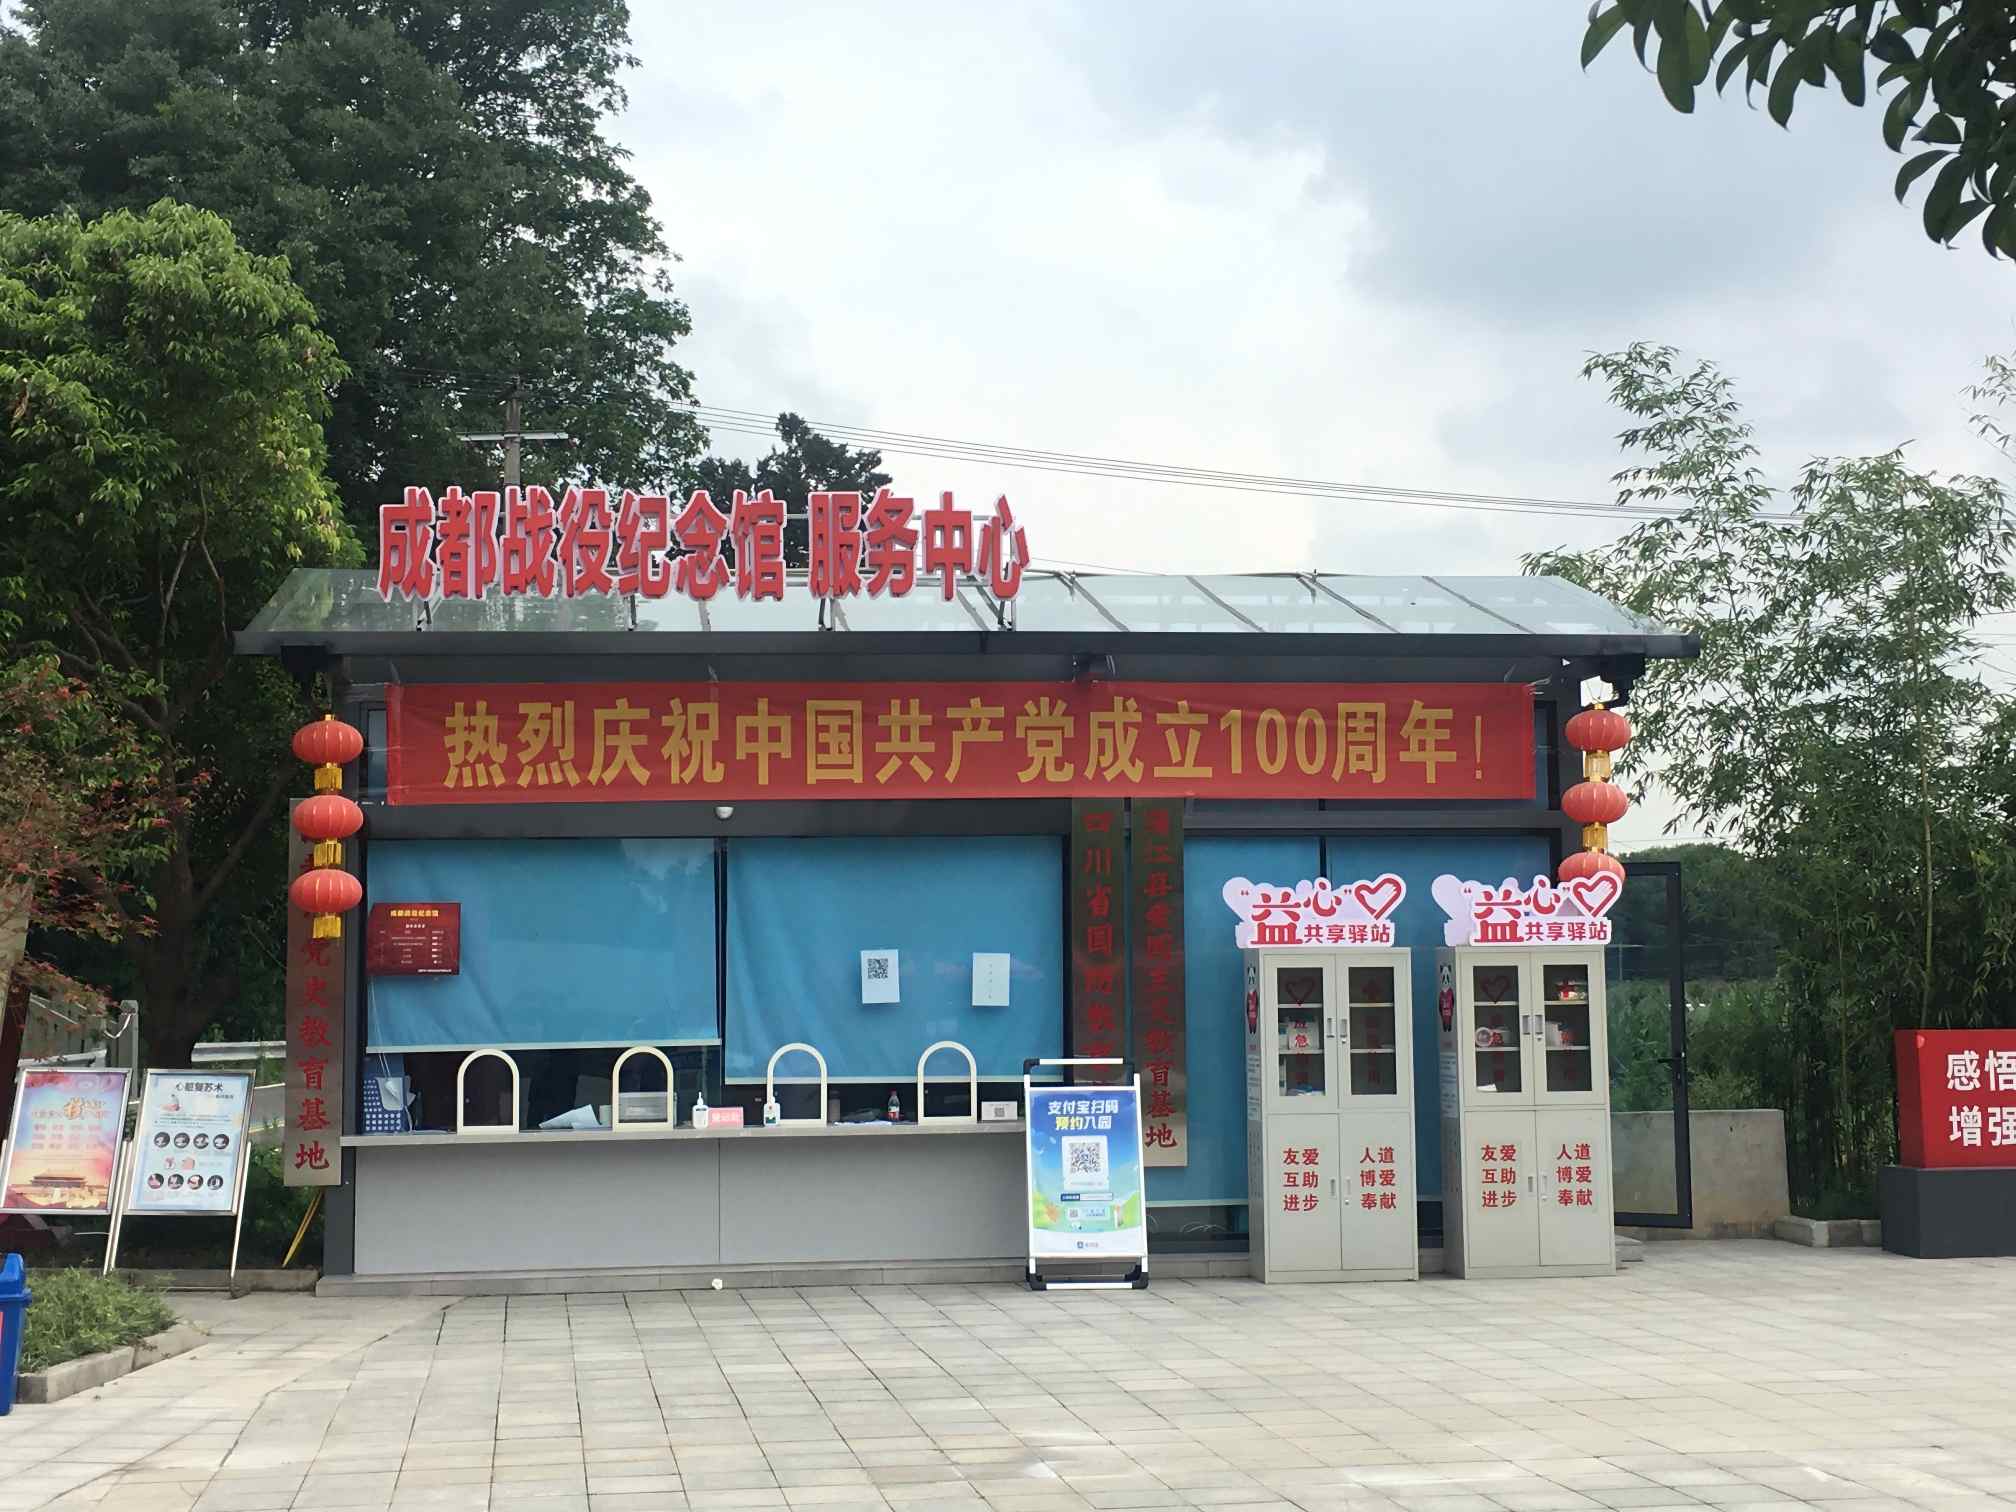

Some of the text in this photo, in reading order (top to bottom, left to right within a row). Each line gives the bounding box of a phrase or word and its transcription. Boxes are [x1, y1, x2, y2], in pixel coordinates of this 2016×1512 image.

[376, 485, 1030, 602] 成都战役纪念馆 服务中心
[1304, 924, 1391, 944] 共享驿站
[1525, 922, 1608, 942] 共享驿站
[1048, 1100, 1120, 1115] 支付宝扫码
[1283, 1148, 1320, 1165] 友爱
[1360, 1147, 1395, 1164] 人道
[1481, 1144, 1518, 1162] 友爱
[1556, 1144, 1592, 1160] 人道
[1283, 1171, 1320, 1188] 互助
[1360, 1170, 1396, 1187] 博爱
[1482, 1167, 1517, 1185] 互助
[1557, 1166, 1592, 1183] 博爱
[1283, 1194, 1320, 1212] 进步
[1360, 1193, 1397, 1210] 奉献
[1482, 1190, 1518, 1208] 进步
[1557, 1189, 1593, 1206] 奉献
